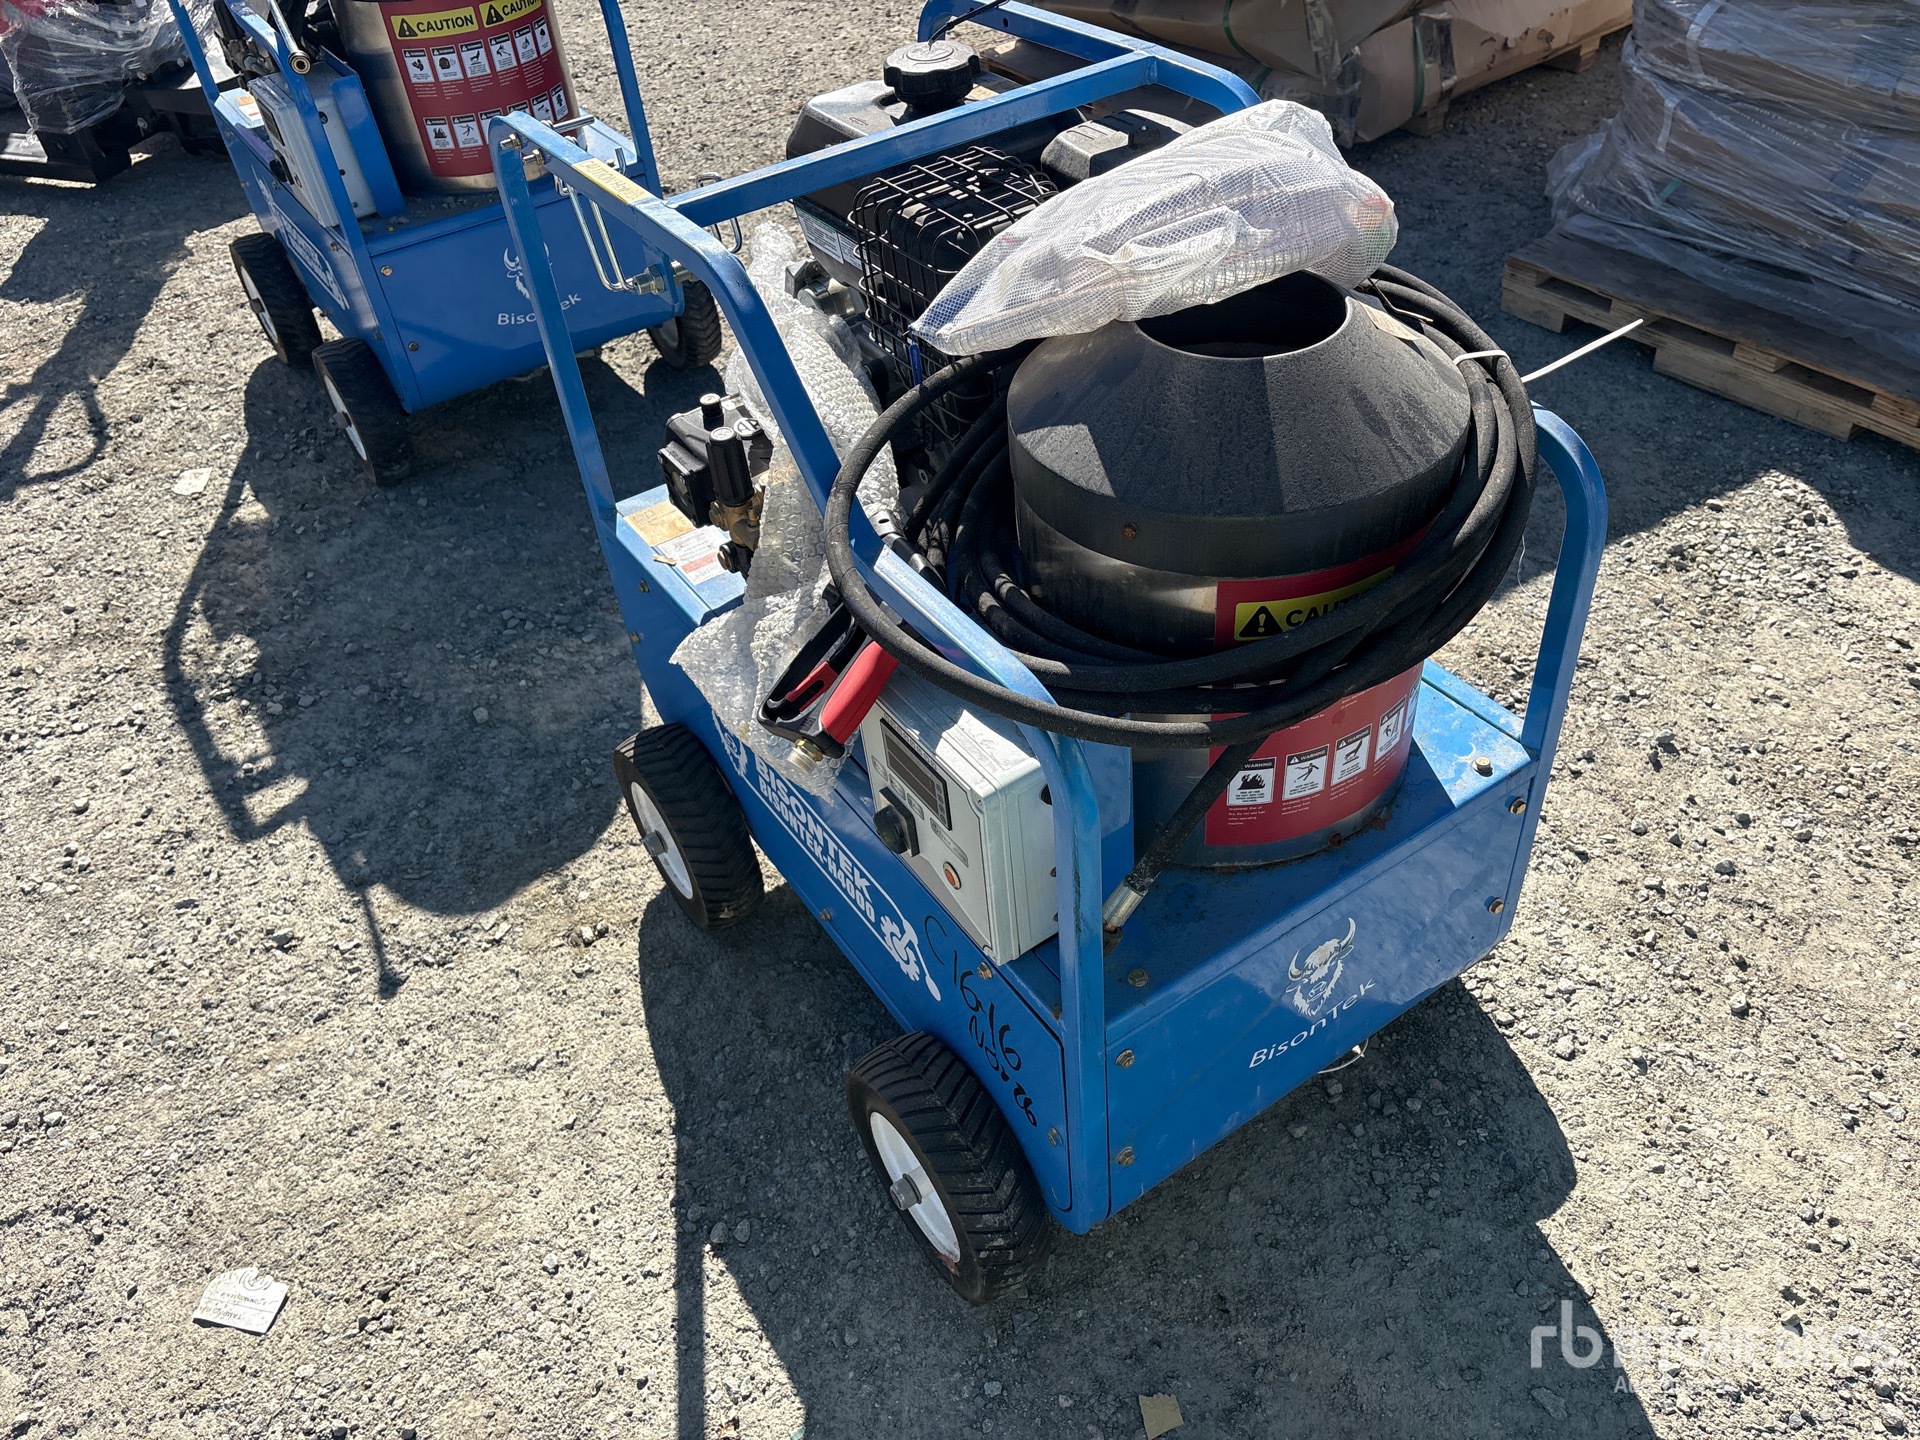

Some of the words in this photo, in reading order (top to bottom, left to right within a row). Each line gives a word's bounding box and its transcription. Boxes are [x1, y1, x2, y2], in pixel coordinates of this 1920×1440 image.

[502, 0, 538, 16] CAUTIO
[416, 14, 475, 33] CAUTION
[497, 293, 582, 325] Bisoek
[1244, 761, 1273, 769] WARNING
[1300, 749, 1326, 761] WARNING
[754, 753, 872, 902] BISONTEK
[758, 774, 875, 923] BISONTEK-H4000
[1248, 979, 1376, 1069] BisonTek
